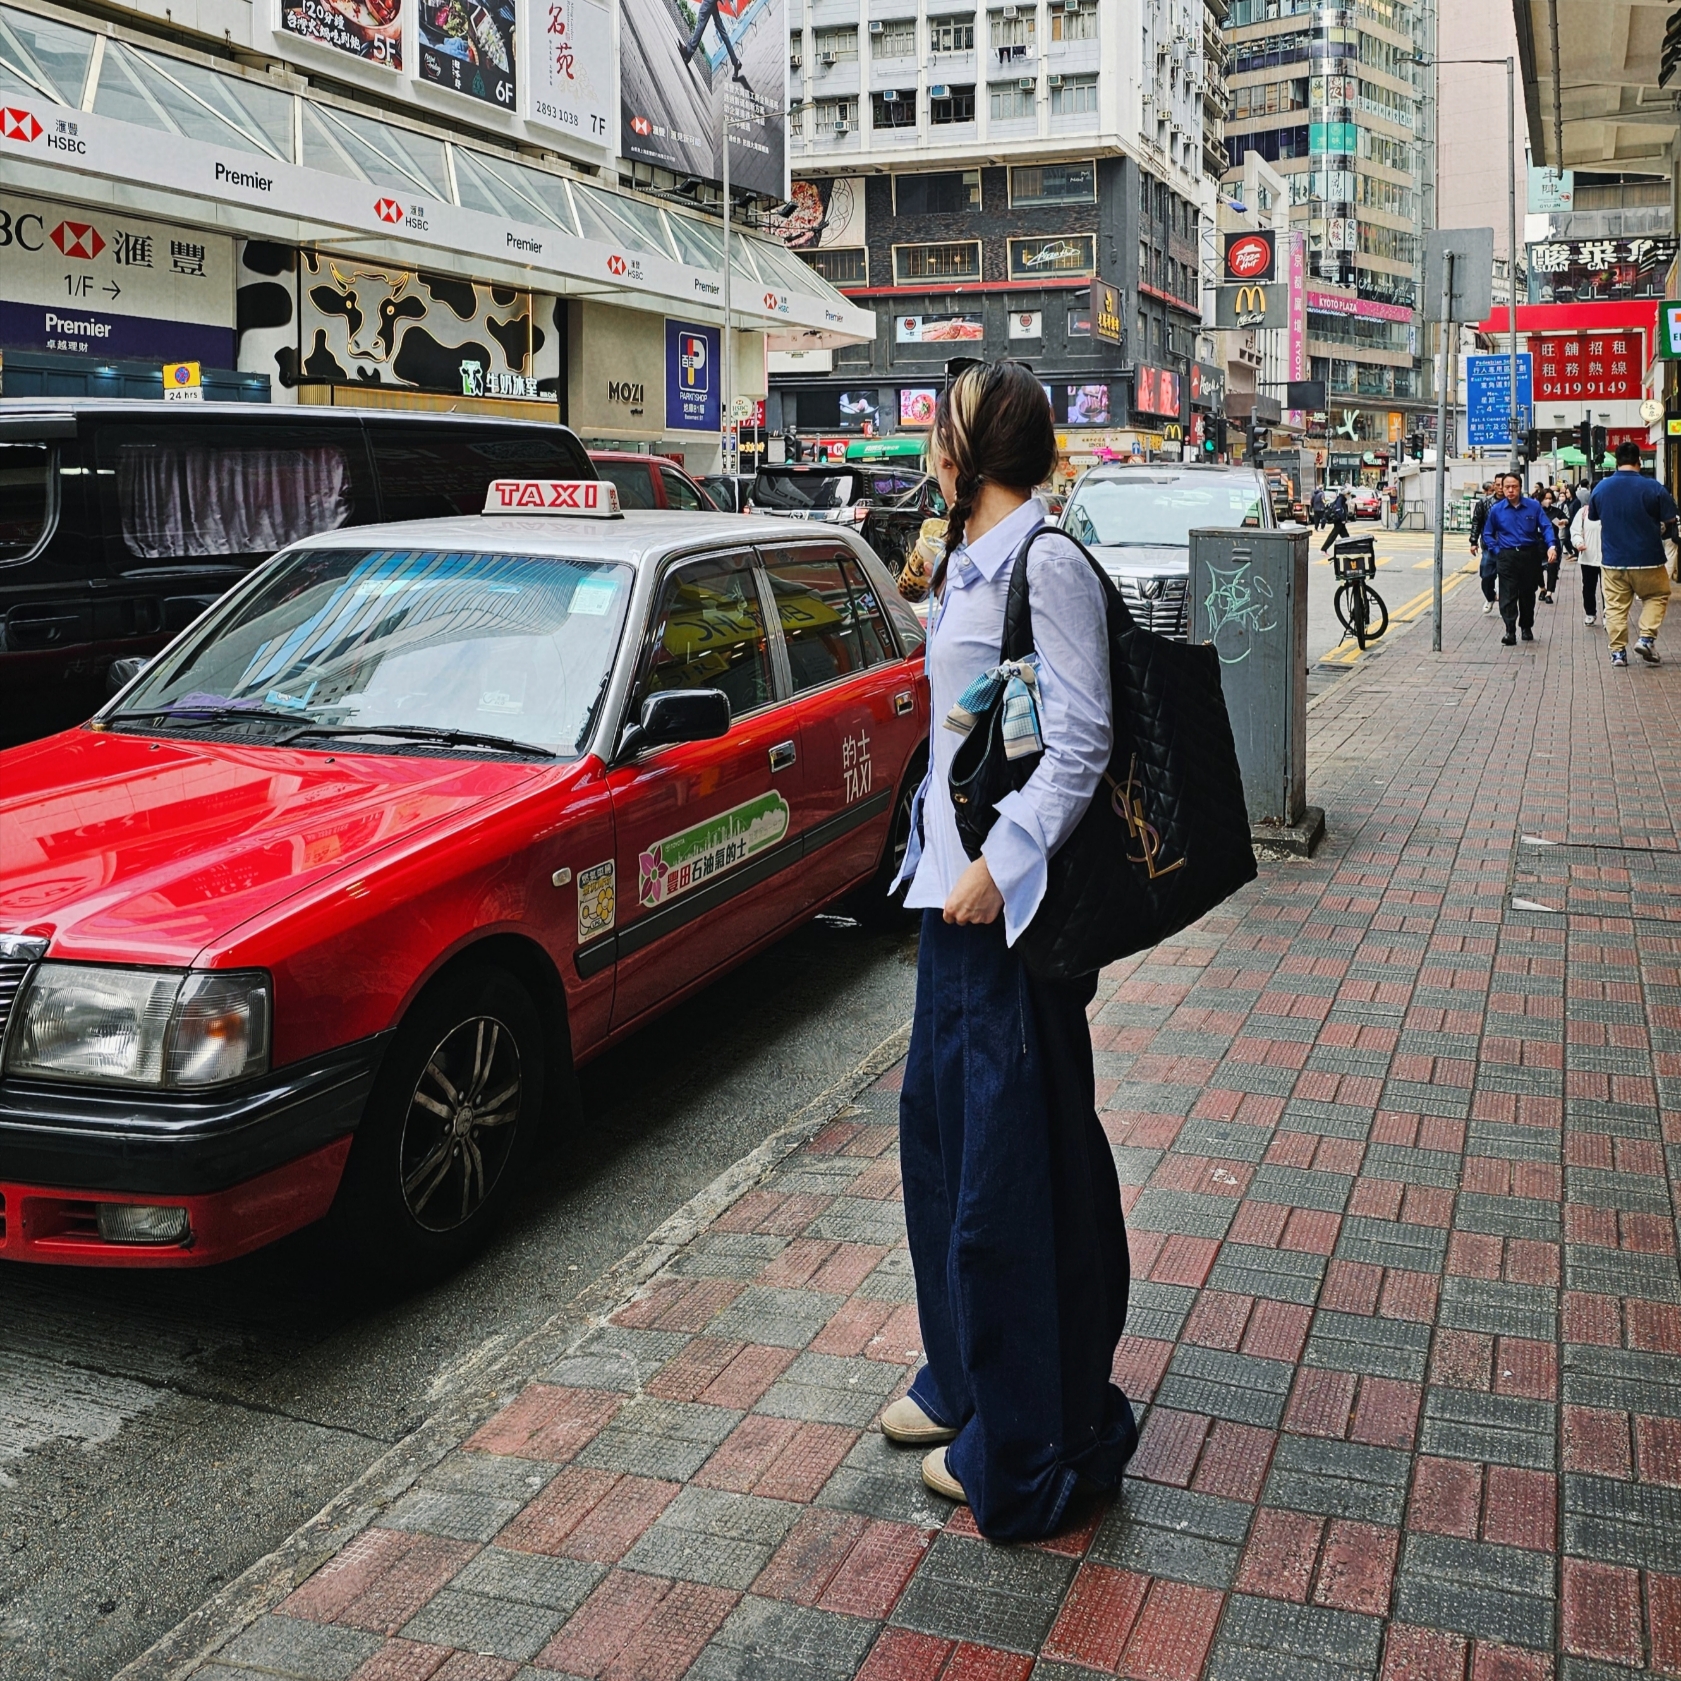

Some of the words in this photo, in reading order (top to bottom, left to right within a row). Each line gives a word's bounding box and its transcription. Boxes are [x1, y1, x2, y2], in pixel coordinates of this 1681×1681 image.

[287, 10, 361, 51] 台灣火鍋吃到飽
[373, 33, 396, 60] 5F
[495, 80, 514, 103] 6F
[536, 101, 557, 119] 2893
[559, 109, 579, 127] 1038
[590, 113, 606, 135] 7F
[47, 134, 87, 155] HSBC
[215, 162, 273, 192] Premier
[405, 216, 429, 232] HSBC
[506, 232, 543, 254] Premier
[1235, 252, 1261, 266] Pizza
[1240, 259, 1259, 271] Hut
[1534, 262, 1569, 273] SUAN
[1587, 262, 1609, 271] CAI
[627, 268, 644, 281] HSBC
[64, 274, 94, 297] 1/F
[694, 278, 720, 295] Premier
[777, 304, 790, 314] HSBC
[1319, 295, 1339, 309] KYOTO
[1340, 300, 1358, 313] PLAZA
[45, 313, 111, 338] Premier
[825, 309, 844, 323] Premier
[46, 339, 89, 353] 卓越理財
[1541, 340, 1628, 357] 旺舖招租
[1473, 365, 1526, 374] 行人專用區劃
[1541, 361, 1628, 377] 租務熱線
[169, 391, 183, 400] 24
[185, 390, 198, 400] hrs
[486, 372, 538, 398] 牛奶冰室
[607, 380, 644, 403] MOZI
[1543, 382, 1582, 396] 9419
[1586, 381, 1627, 395] 9149
[495, 482, 598, 509] TAXI
[609, 488, 618, 512] 的士
[842, 728, 871, 770] 的士
[843, 760, 872, 804] TAXI
[666, 837, 747, 896] 豐田石油氣的士
